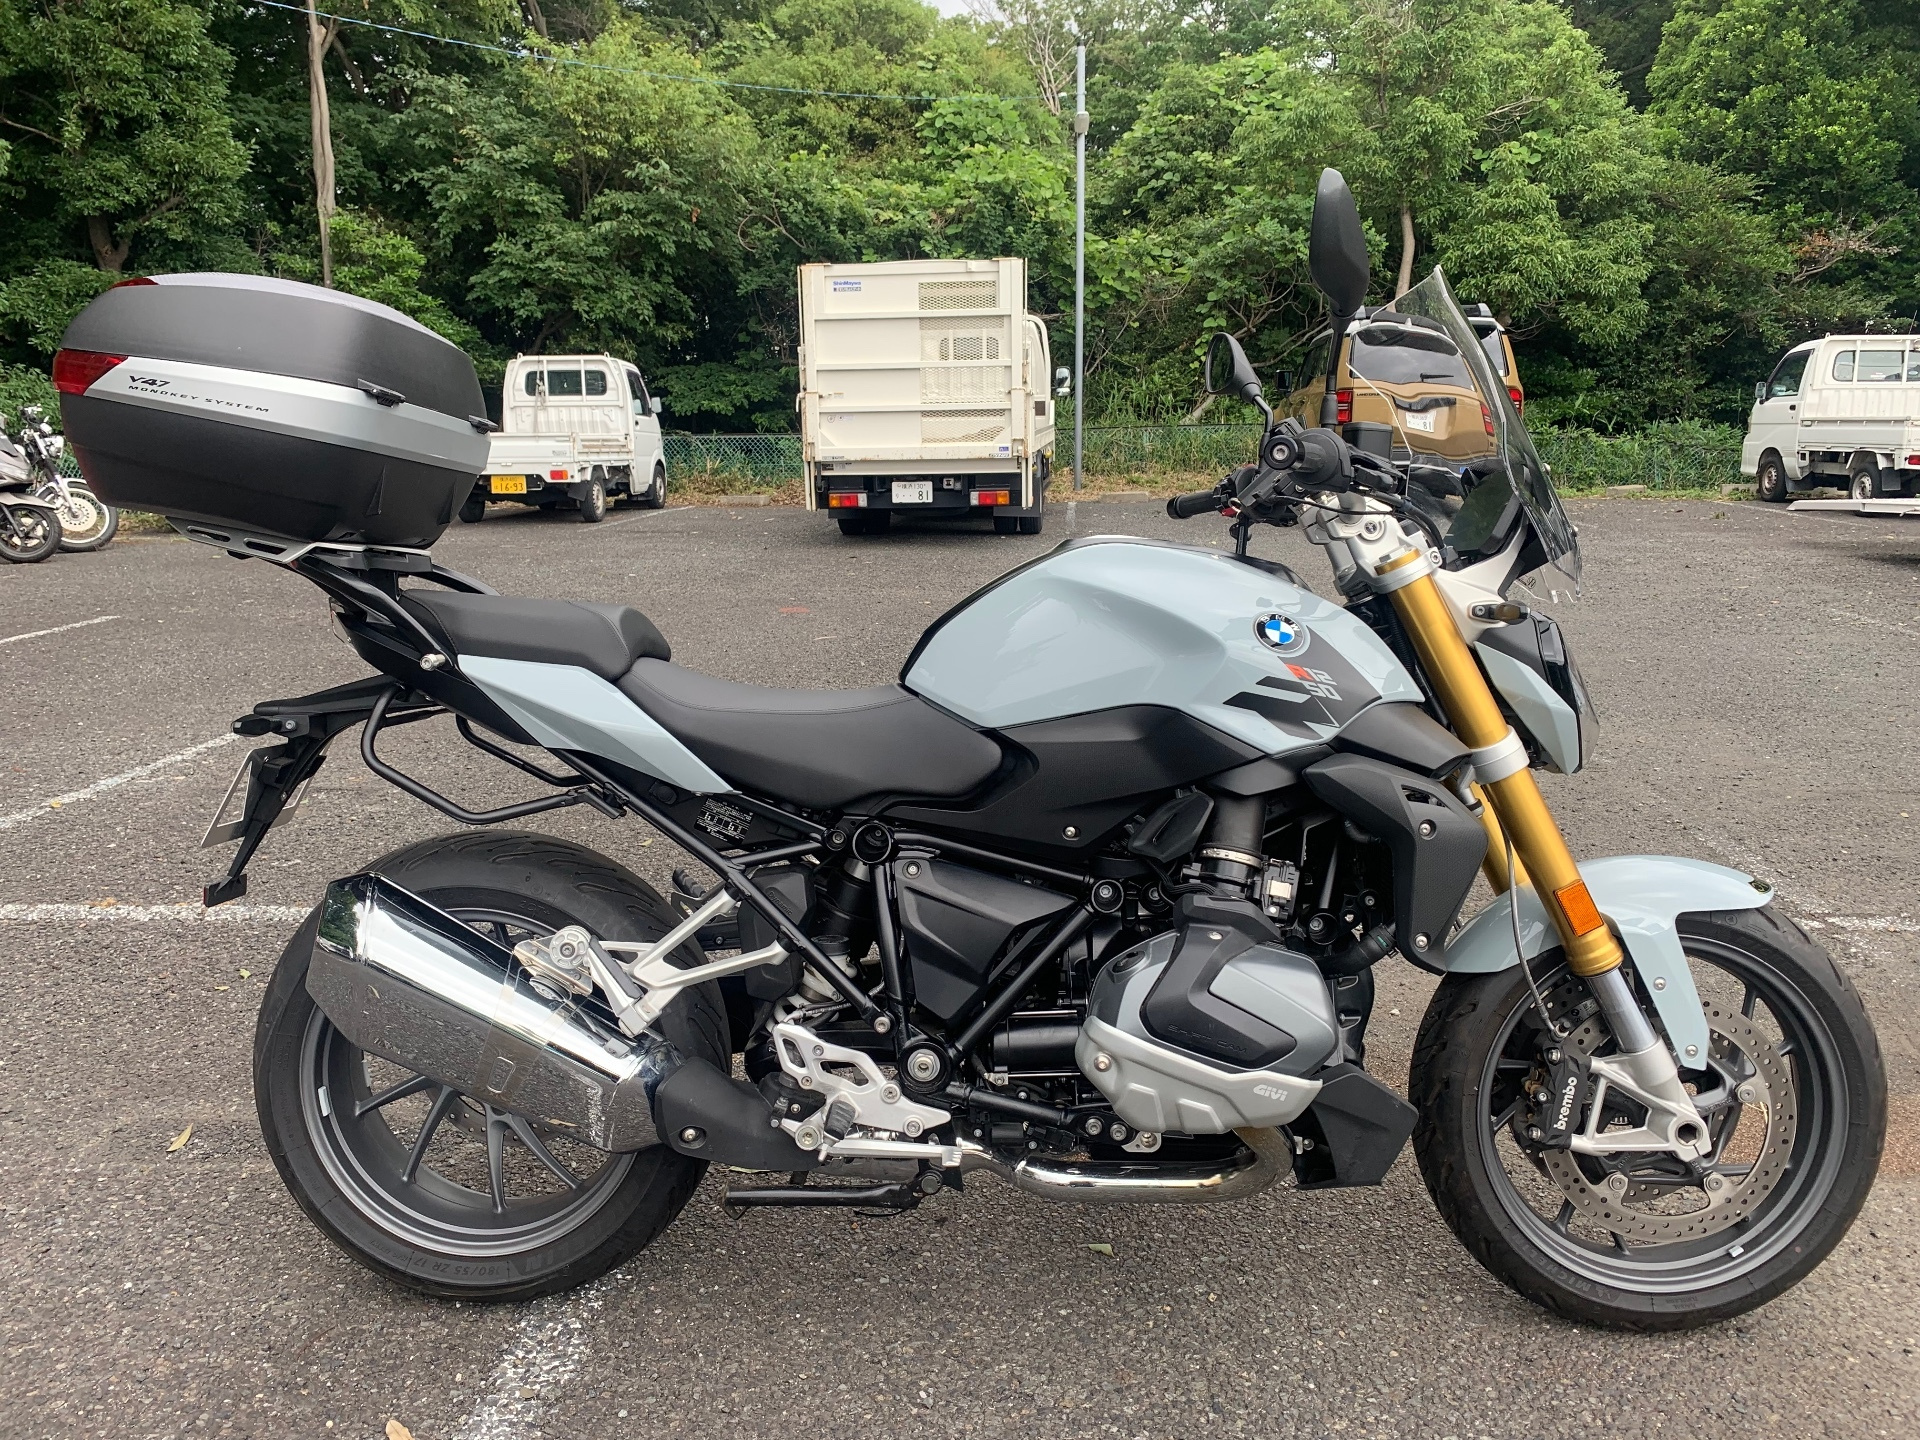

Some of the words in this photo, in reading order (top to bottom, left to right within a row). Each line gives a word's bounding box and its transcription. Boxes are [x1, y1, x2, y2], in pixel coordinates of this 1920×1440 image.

[129, 375, 171, 388] V47
[128, 385, 199, 400] MONOKEY
[205, 398, 269, 412] SYSTEM
[1260, 614, 1300, 632] BMW
[1253, 1084, 1288, 1102] GIVI
[1553, 1077, 1577, 1130] brembo
